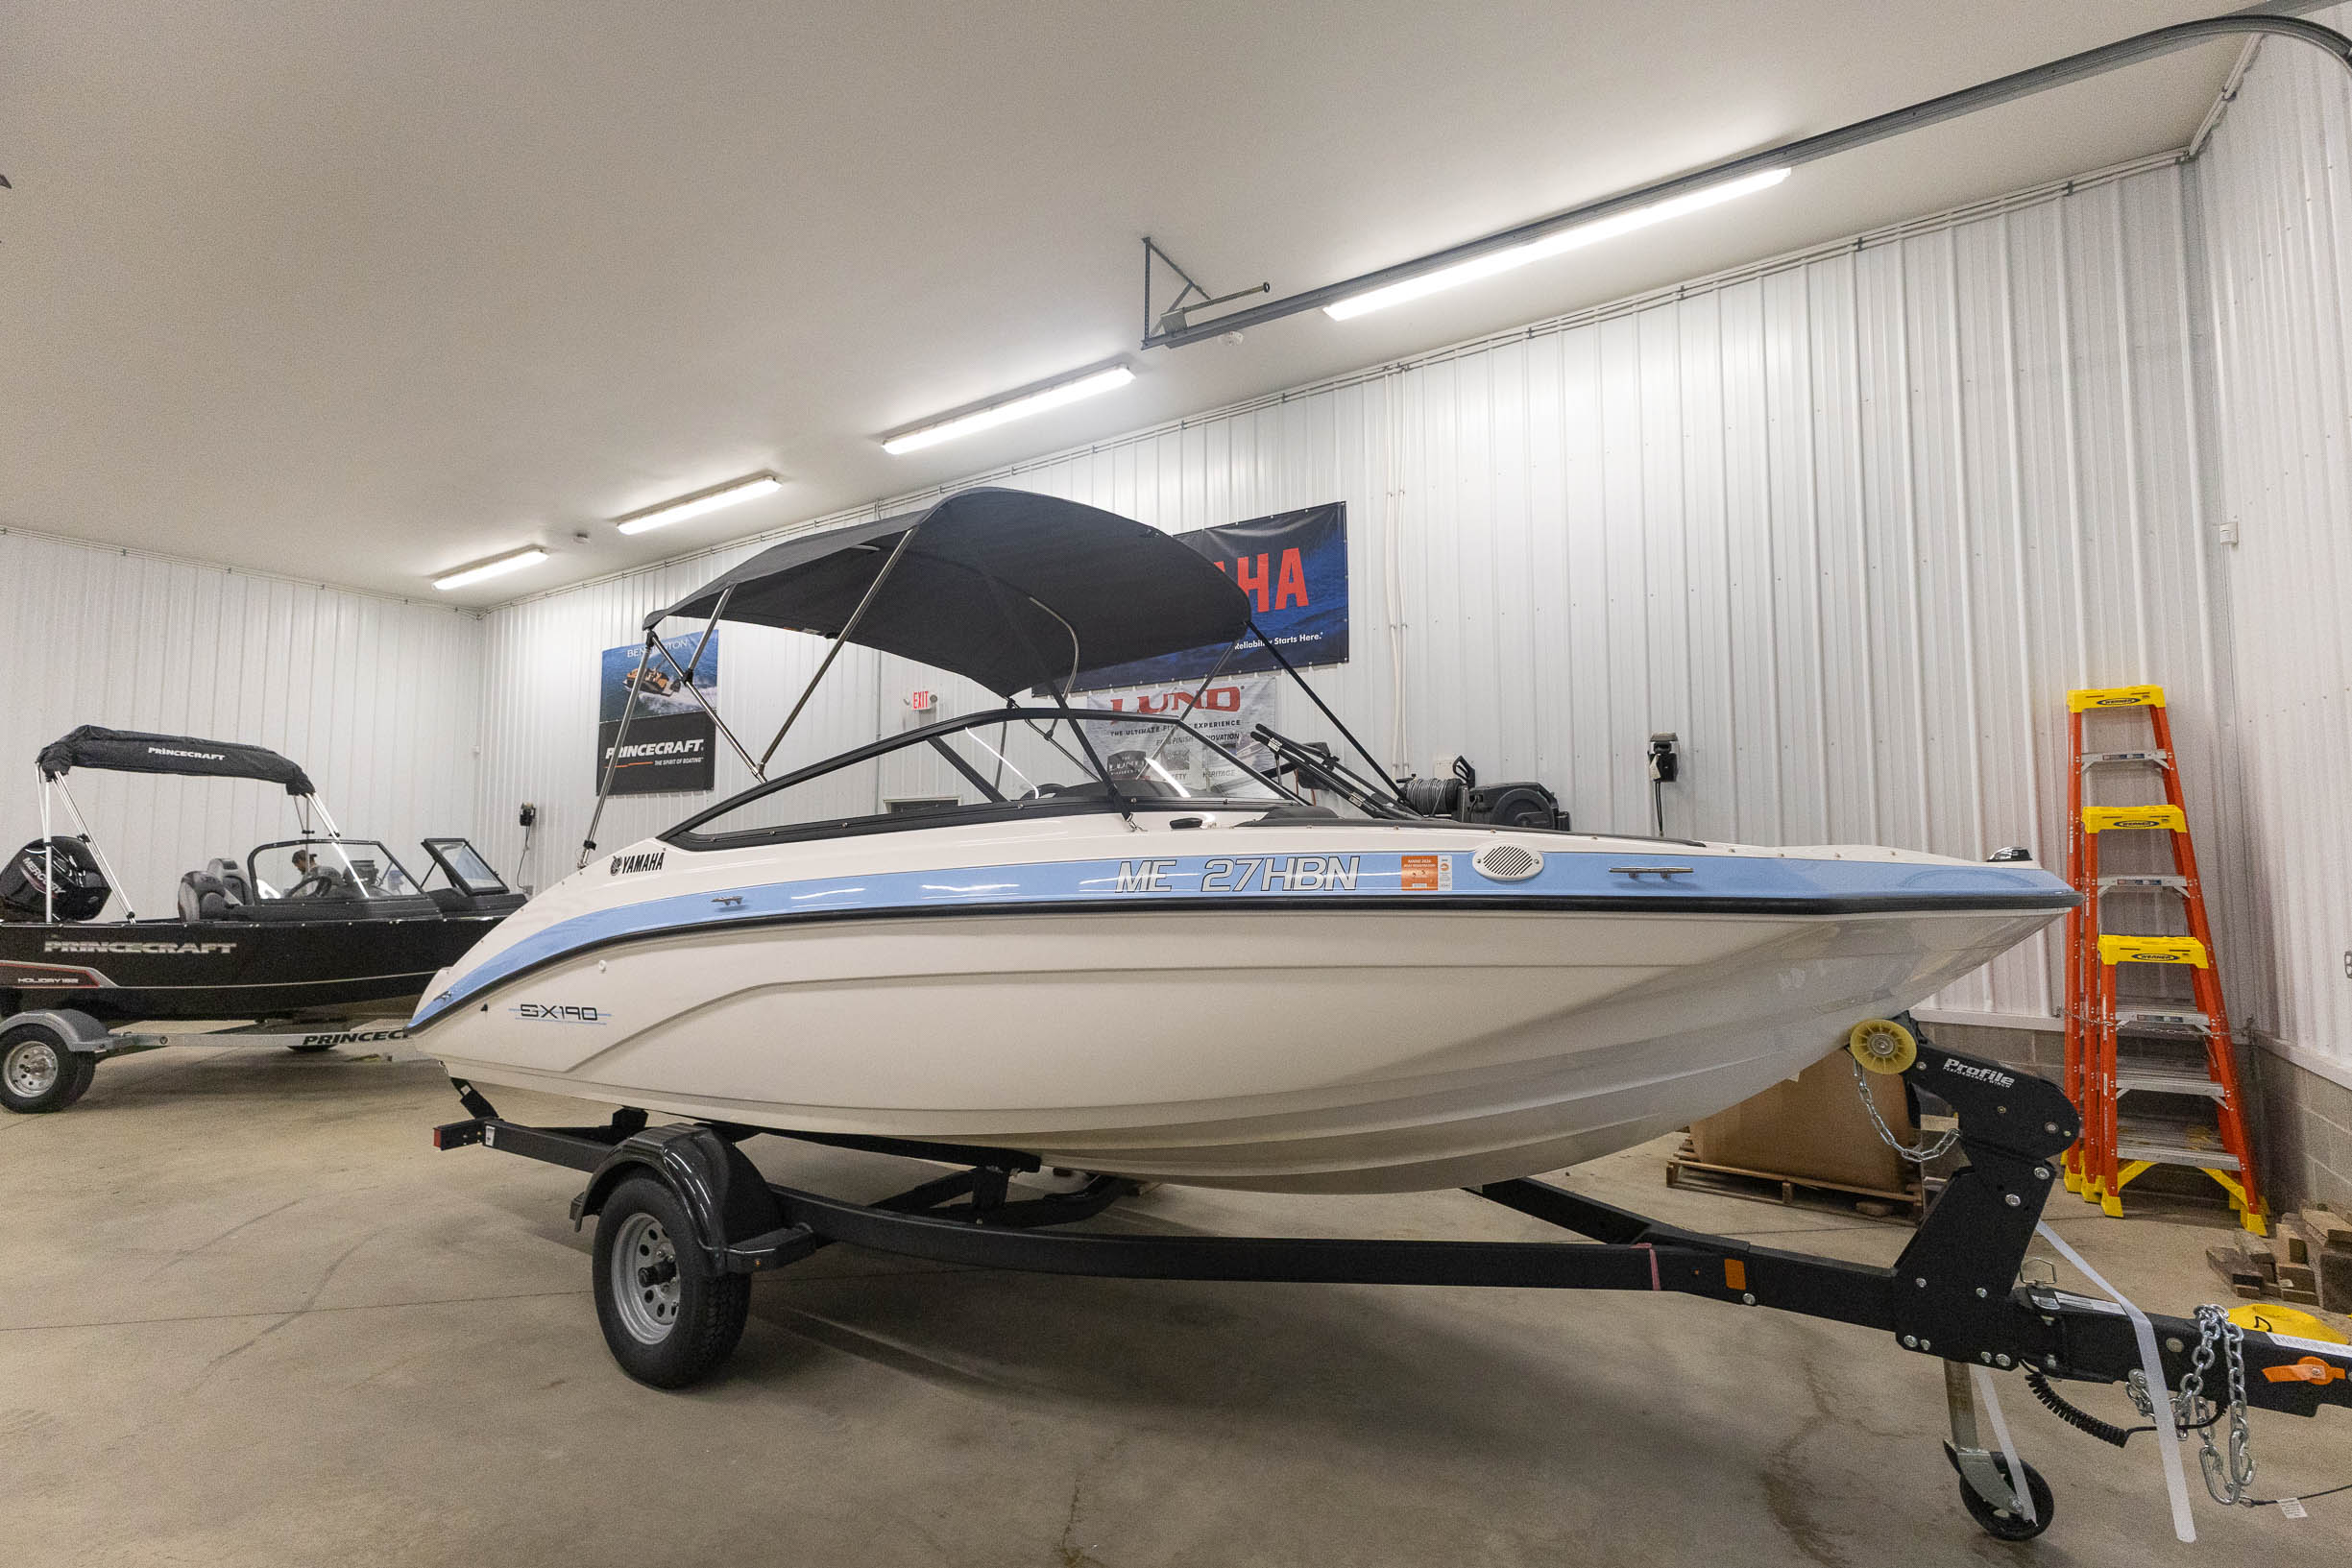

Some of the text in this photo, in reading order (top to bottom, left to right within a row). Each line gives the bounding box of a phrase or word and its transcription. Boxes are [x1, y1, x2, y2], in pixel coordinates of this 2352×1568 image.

[627, 639, 689, 658] BENTON
[1274, 636, 1297, 645] Starts
[913, 691, 929, 709] EXIT
[1126, 726, 1160, 736] ULTIMATE
[1194, 719, 1241, 730] EXPERIENCE
[148, 747, 226, 760] PRINCECRAFT
[622, 852, 665, 874] YAMAHA
[1115, 856, 1361, 894] ME 27HBN
[44, 941, 237, 953] PRINCECRAFT
[303, 1029, 408, 1045] PRINCEC
[1943, 1058, 2015, 1084] Profile
